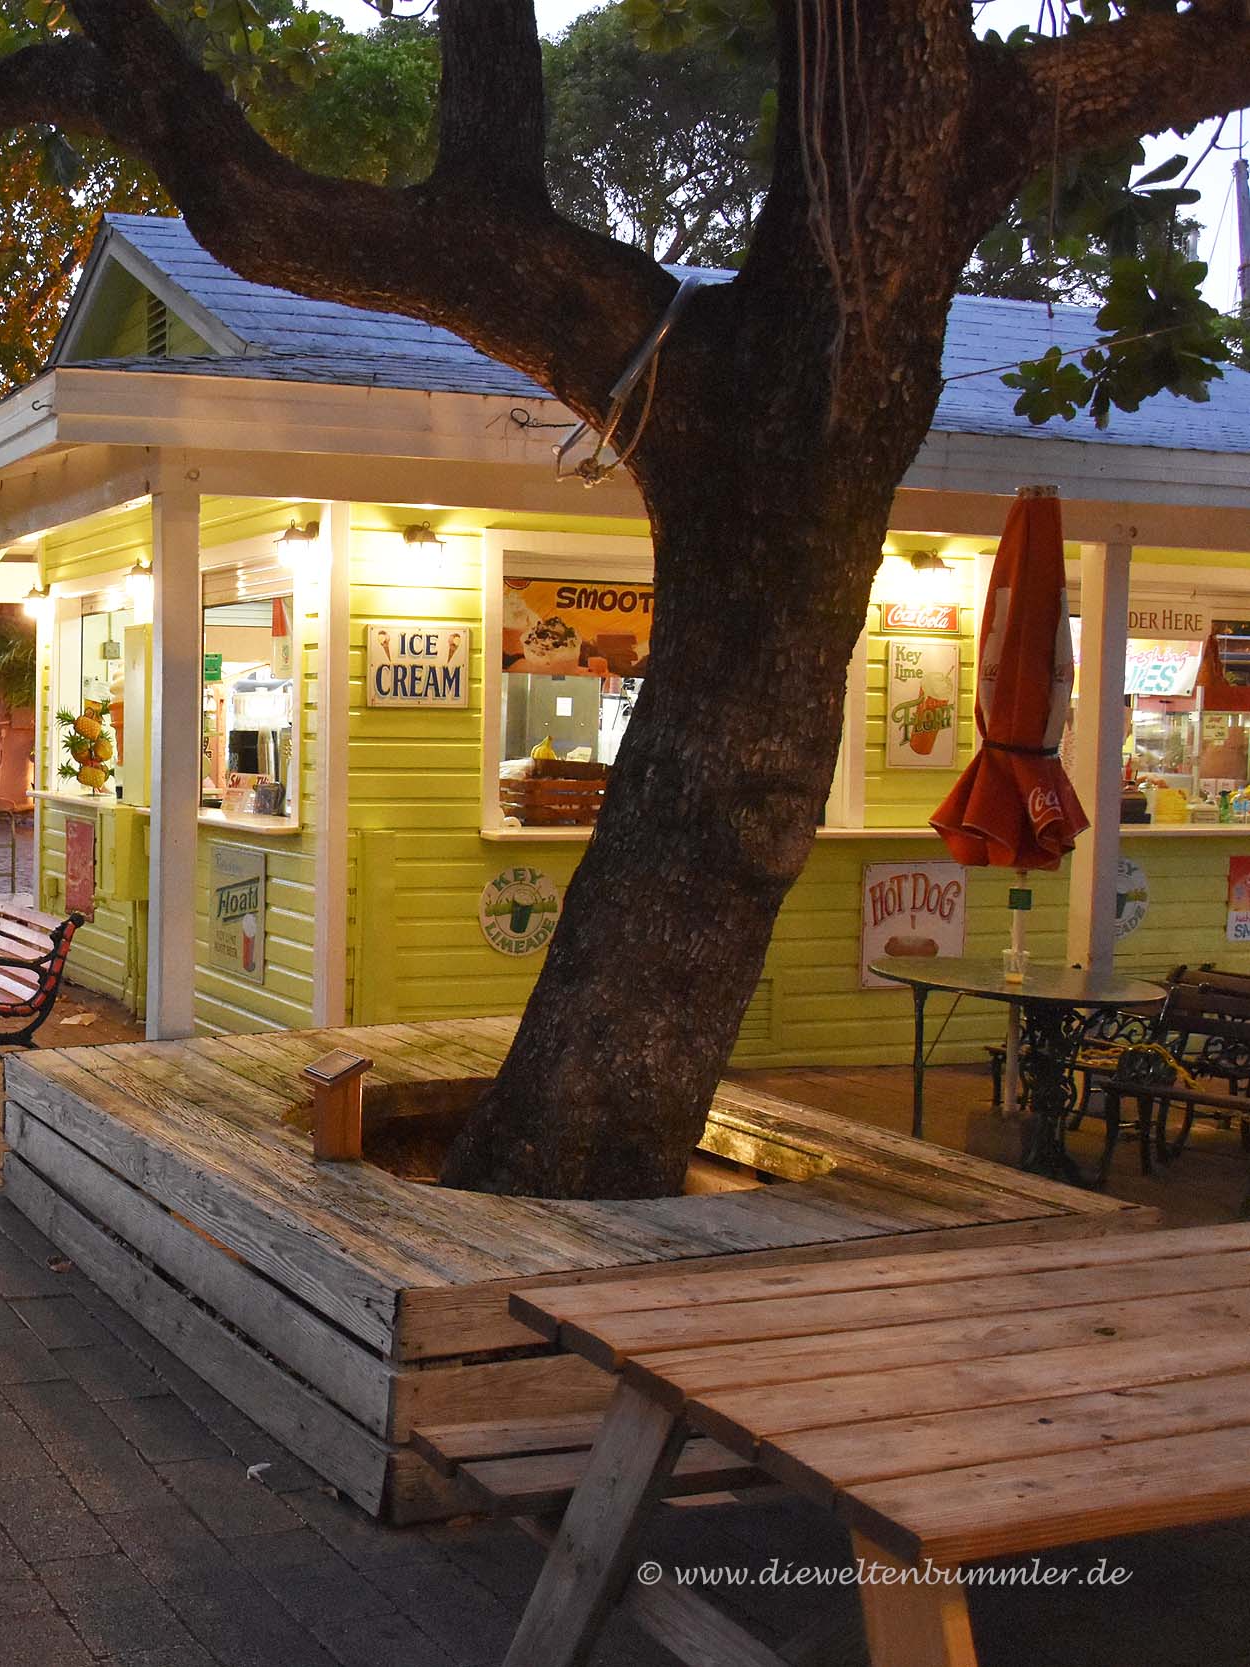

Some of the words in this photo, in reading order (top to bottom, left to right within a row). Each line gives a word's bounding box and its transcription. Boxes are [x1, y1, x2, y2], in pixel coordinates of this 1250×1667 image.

[1162, 609, 1203, 632] HERE
[399, 633, 439, 657] ICE
[895, 645, 922, 665] Key
[375, 663, 461, 698] CREAM
[894, 663, 924, 682] Lime
[493, 867, 545, 892] KEY
[484, 917, 556, 954] LIMEADE
